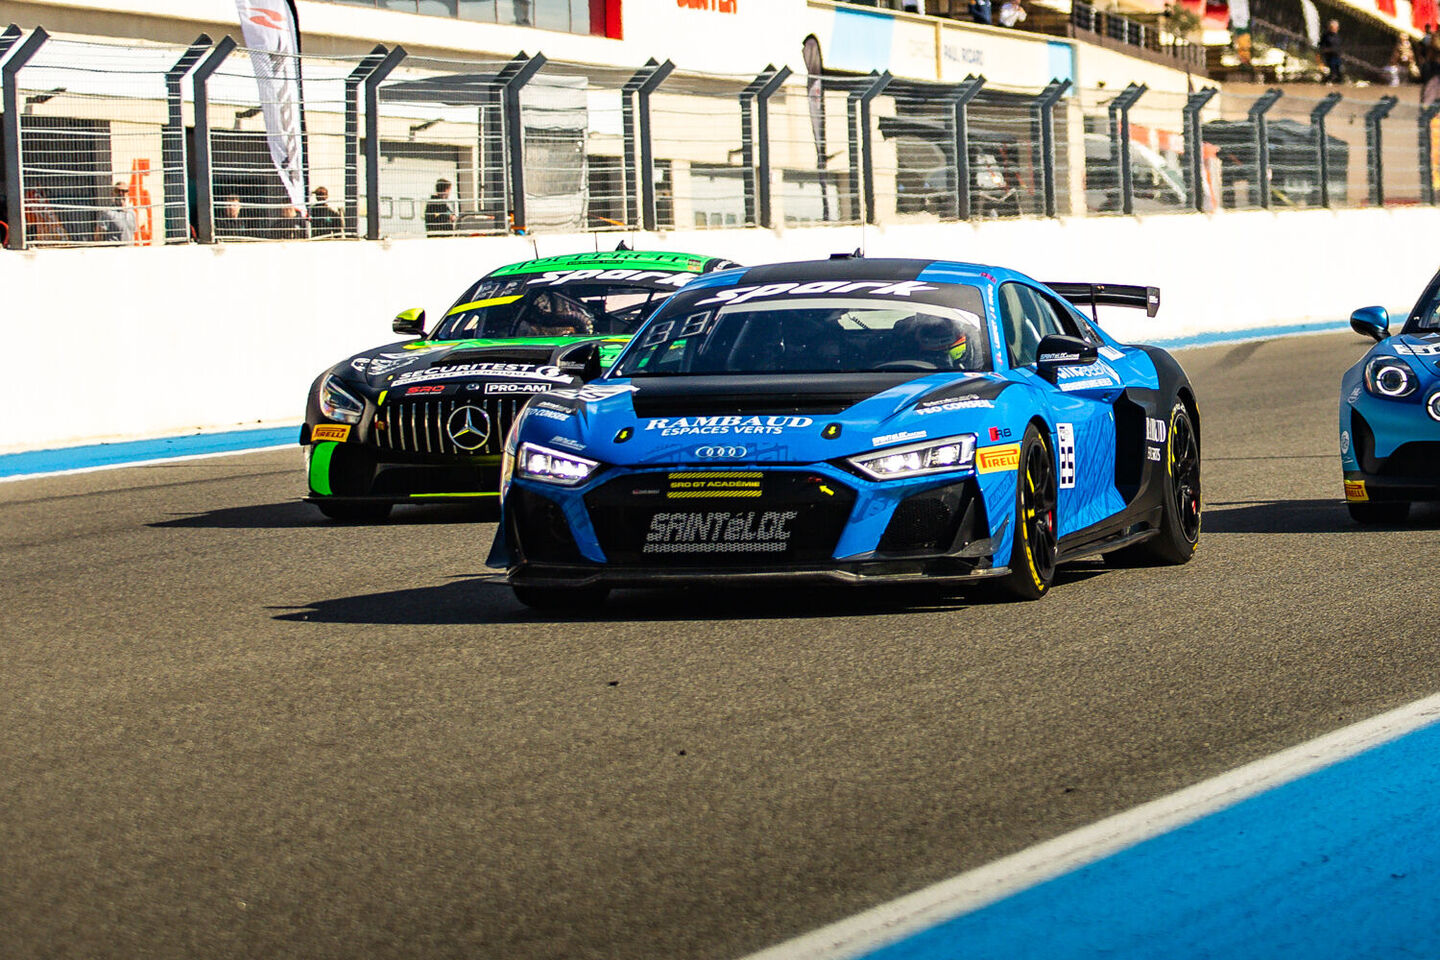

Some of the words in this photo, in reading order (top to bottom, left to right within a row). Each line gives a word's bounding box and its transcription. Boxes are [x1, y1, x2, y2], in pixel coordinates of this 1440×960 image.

[695, 280, 939, 306] spark
[399, 362, 536, 380] SECURITEST
[489, 384, 547, 392] PRO-AM
[645, 416, 813, 430] RAMBAUD
[661, 426, 733, 436] ESPACES
[734, 425, 783, 434] VERTS
